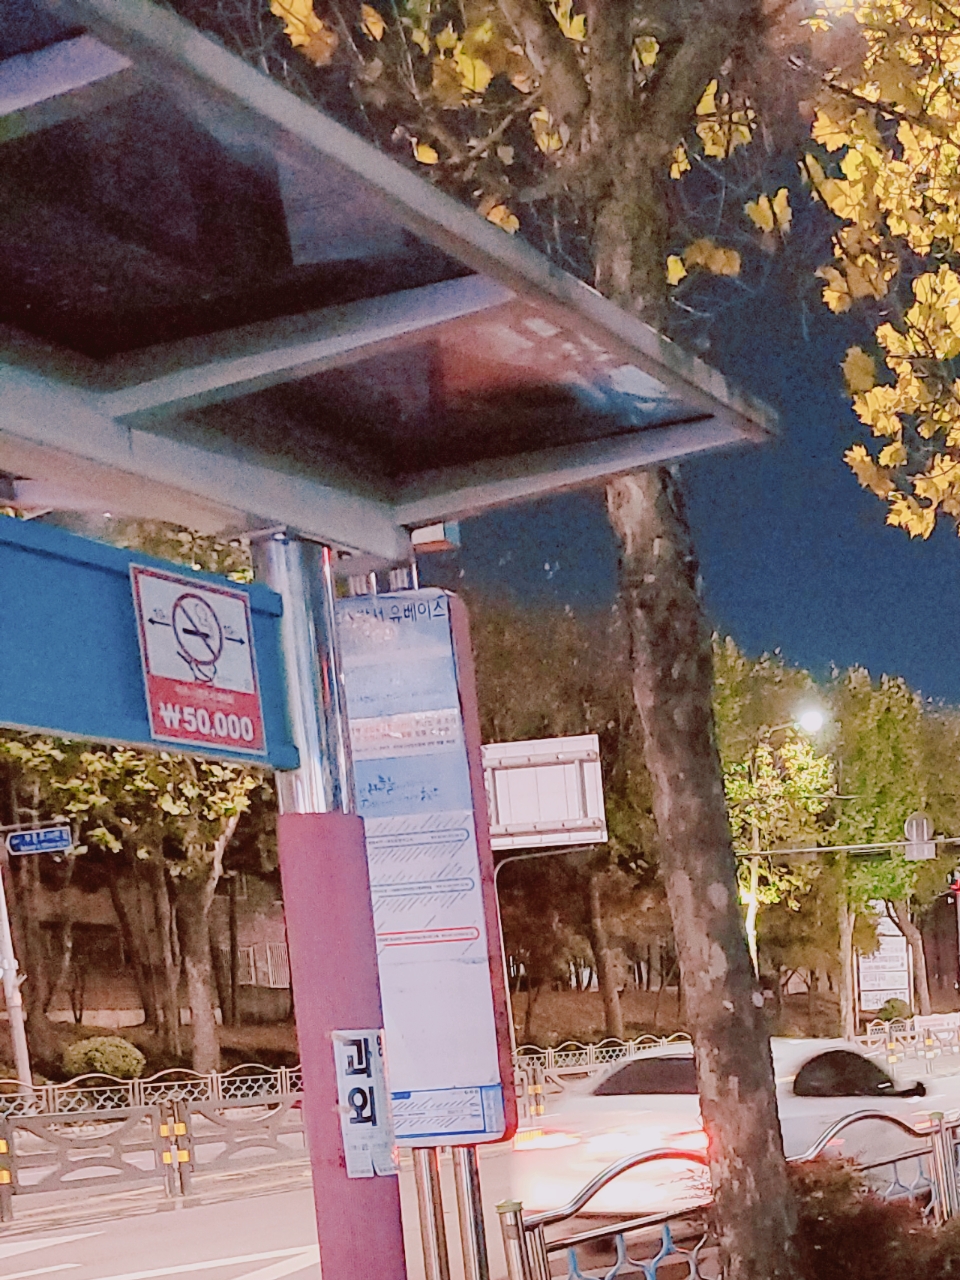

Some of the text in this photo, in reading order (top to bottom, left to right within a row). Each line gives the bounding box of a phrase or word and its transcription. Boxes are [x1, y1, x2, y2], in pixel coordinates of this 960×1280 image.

[389, 600, 447, 623] 유베이스
[159, 701, 254, 742] ₩50,000
[343, 1037, 378, 1127] 과외
